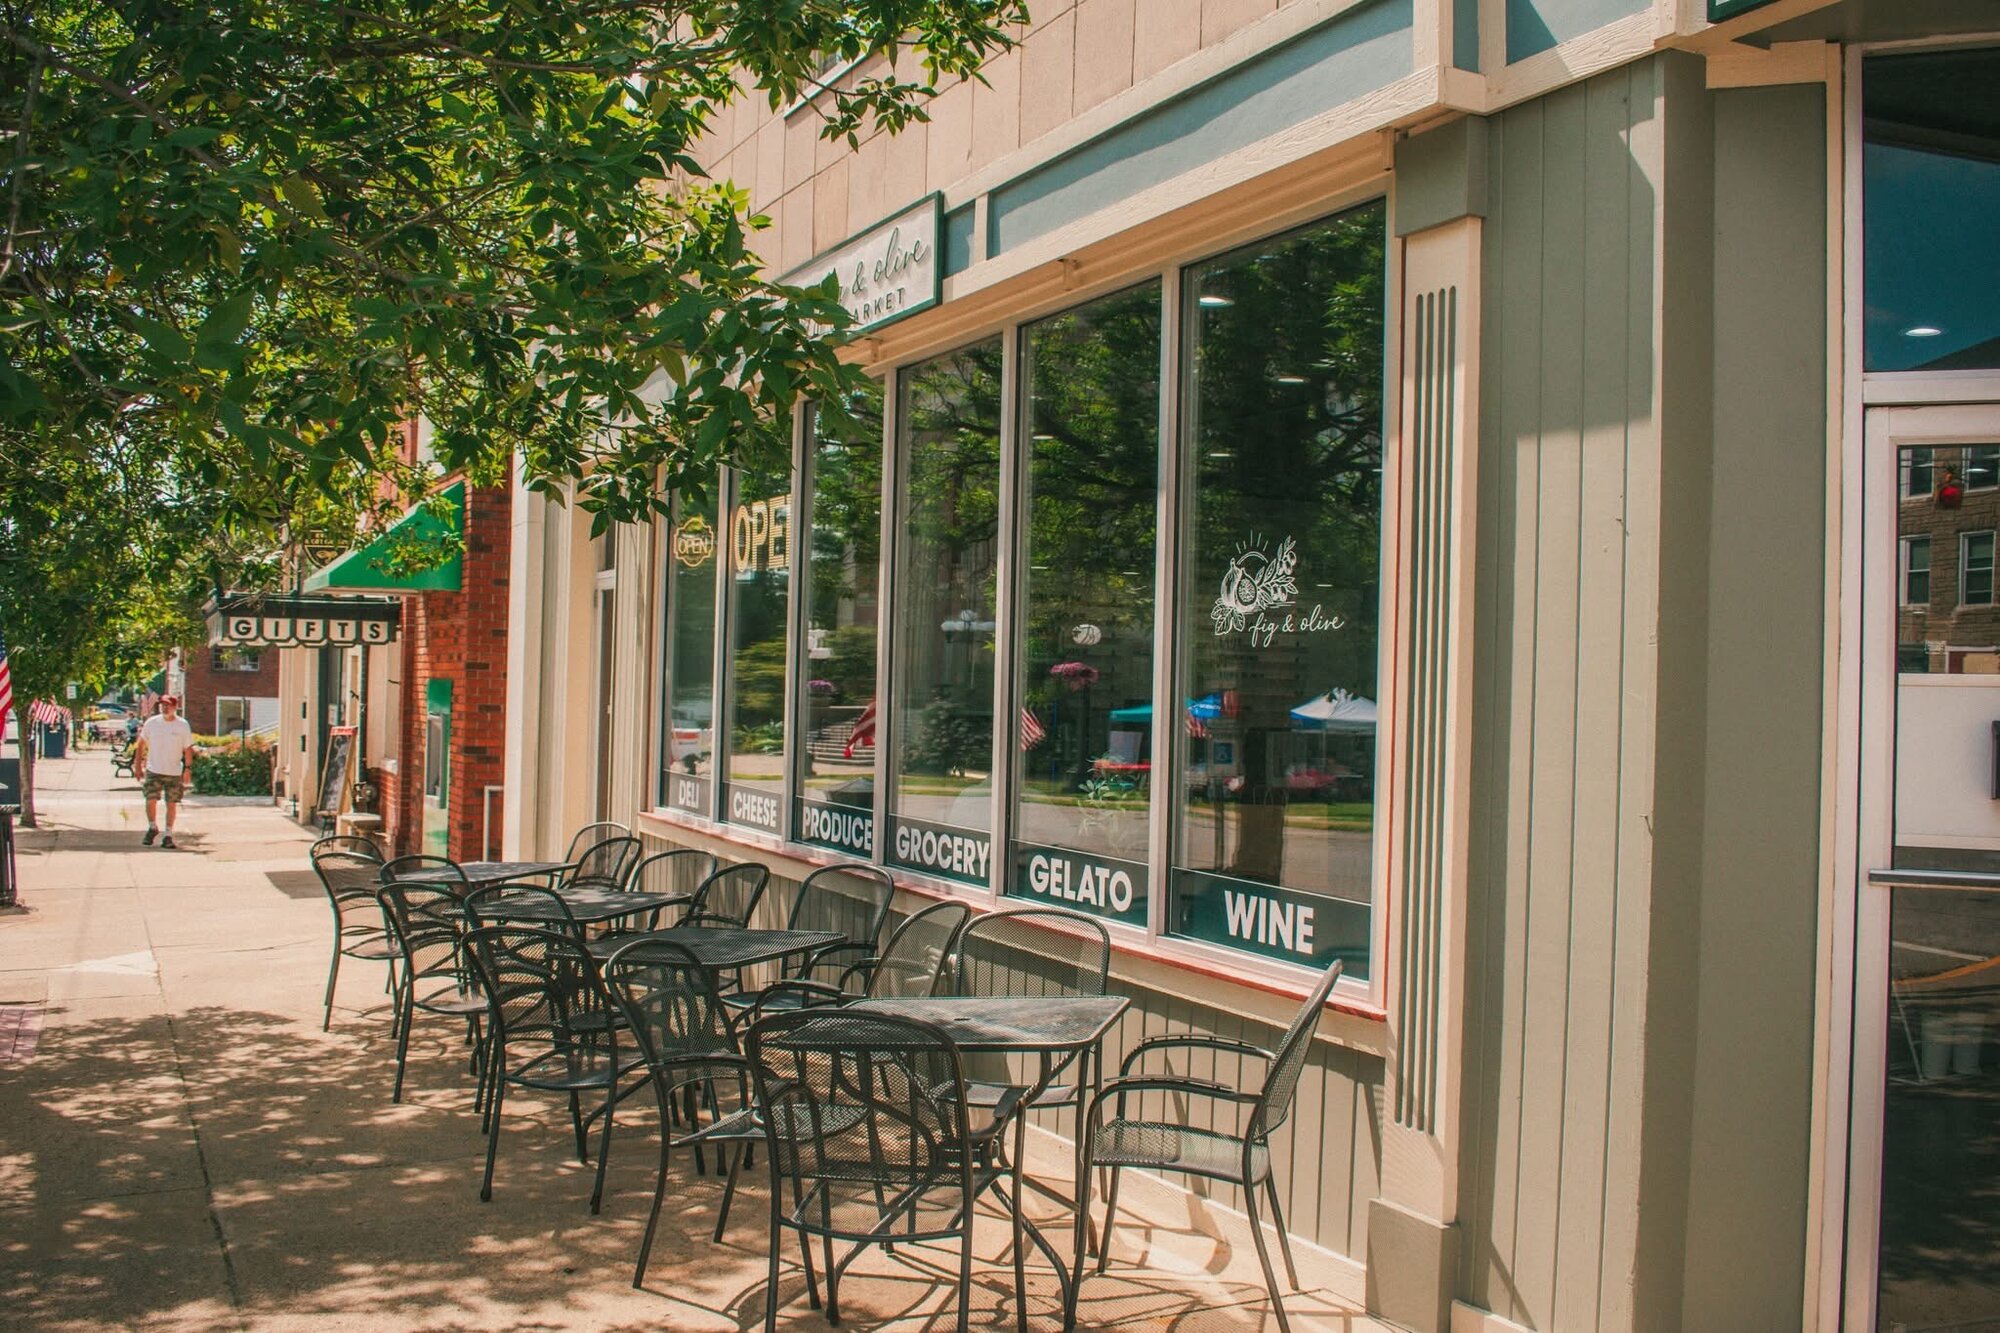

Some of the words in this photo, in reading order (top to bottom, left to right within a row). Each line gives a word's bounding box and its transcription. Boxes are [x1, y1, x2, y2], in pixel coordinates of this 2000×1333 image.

[852, 261, 865, 295] &
[874, 227, 929, 282] olive
[853, 288, 905, 321] ARKET
[678, 537, 708, 554] OPEN
[235, 620, 381, 640] GIFTS
[1249, 612, 1279, 648] fig
[1282, 614, 1295, 633] &
[1300, 604, 1345, 632] olive
[679, 780, 700, 809] DELI
[733, 791, 777, 828] CHEESE
[802, 806, 873, 851] PRODUCE
[896, 825, 990, 878] GROCERY
[1029, 854, 1133, 913] GELATO
[1224, 890, 1314, 955] WINE
